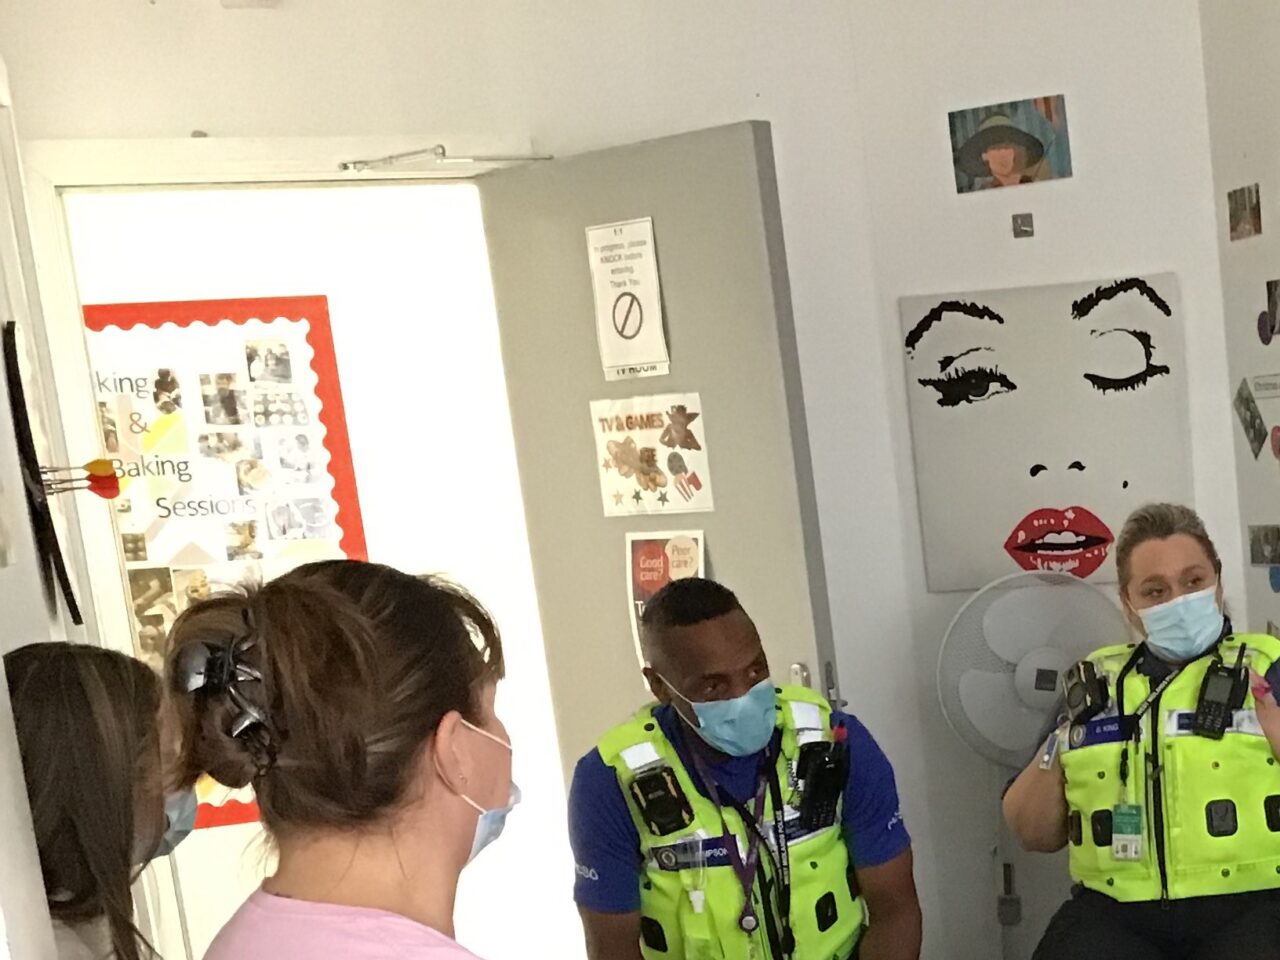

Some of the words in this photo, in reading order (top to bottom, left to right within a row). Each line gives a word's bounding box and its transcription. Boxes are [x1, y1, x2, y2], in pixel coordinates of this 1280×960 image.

[129, 411, 152, 434] &
[599, 417, 614, 433] TV
[625, 412, 665, 431] GAMES
[111, 454, 193, 483] Baking
[639, 555, 664, 568] Good
